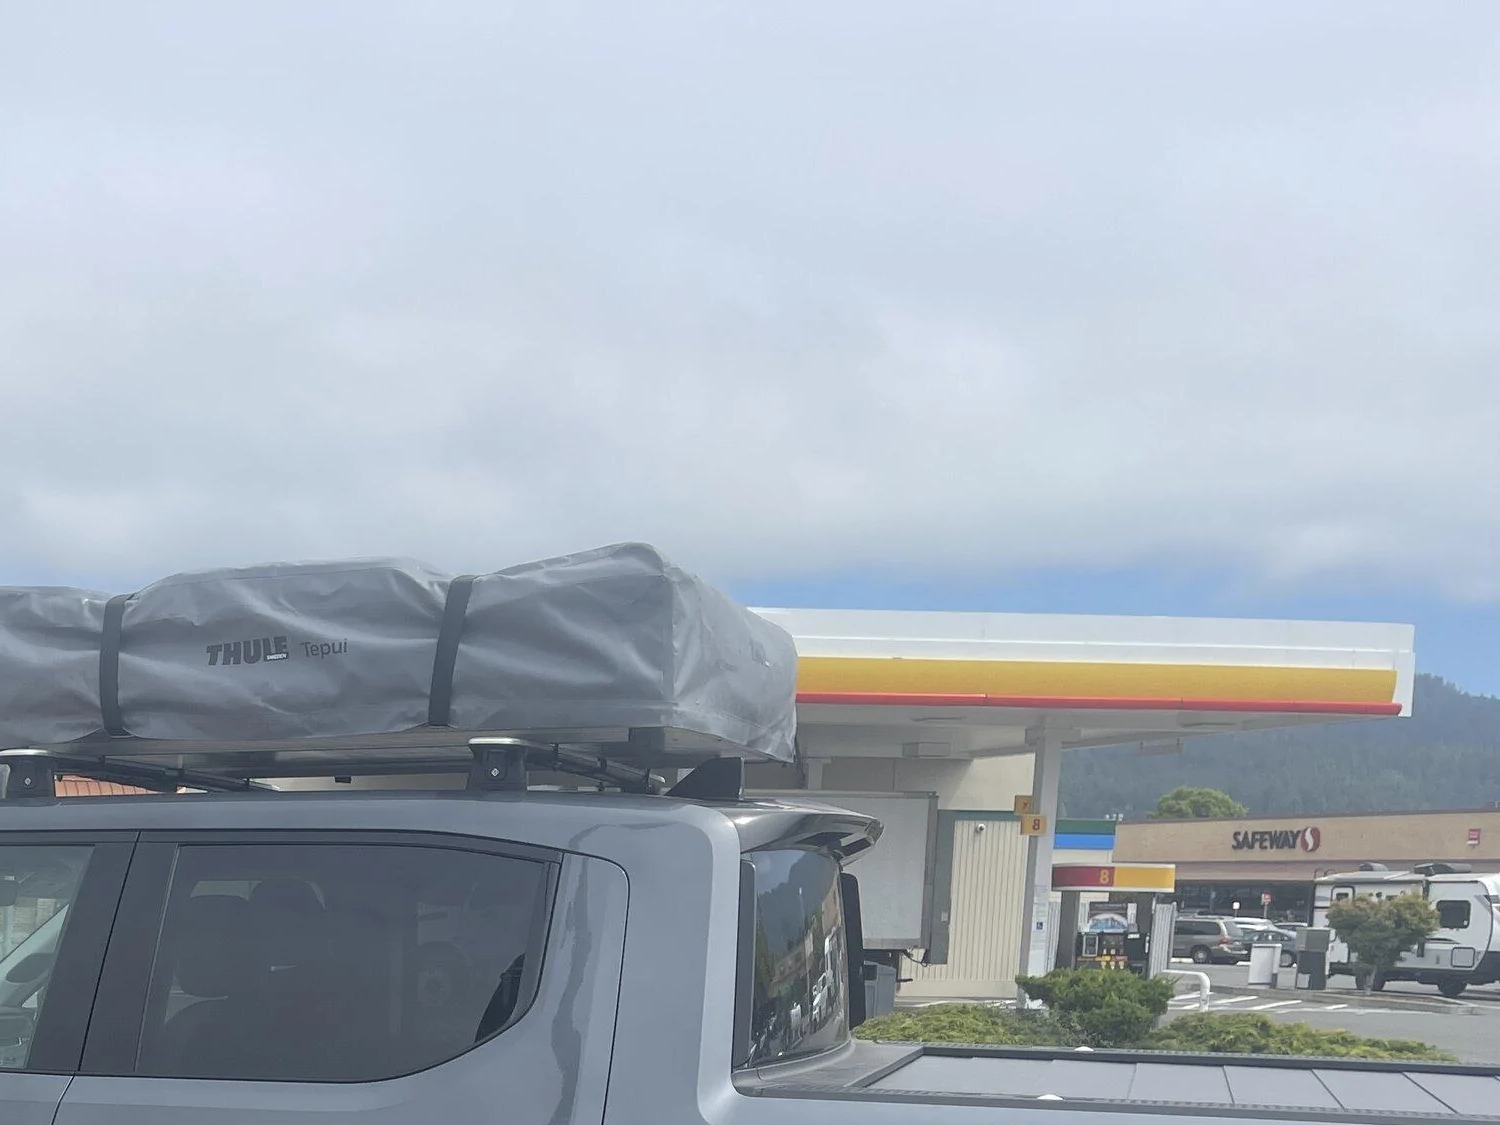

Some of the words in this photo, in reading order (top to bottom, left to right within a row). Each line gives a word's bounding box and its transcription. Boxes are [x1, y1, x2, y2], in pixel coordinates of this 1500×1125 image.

[206, 636, 289, 666] THULE
[300, 638, 348, 659] Tepui
[1032, 819, 1040, 831] 8
[1232, 830, 1301, 850] SAFEWAY
[1100, 869, 1110, 884] 8
